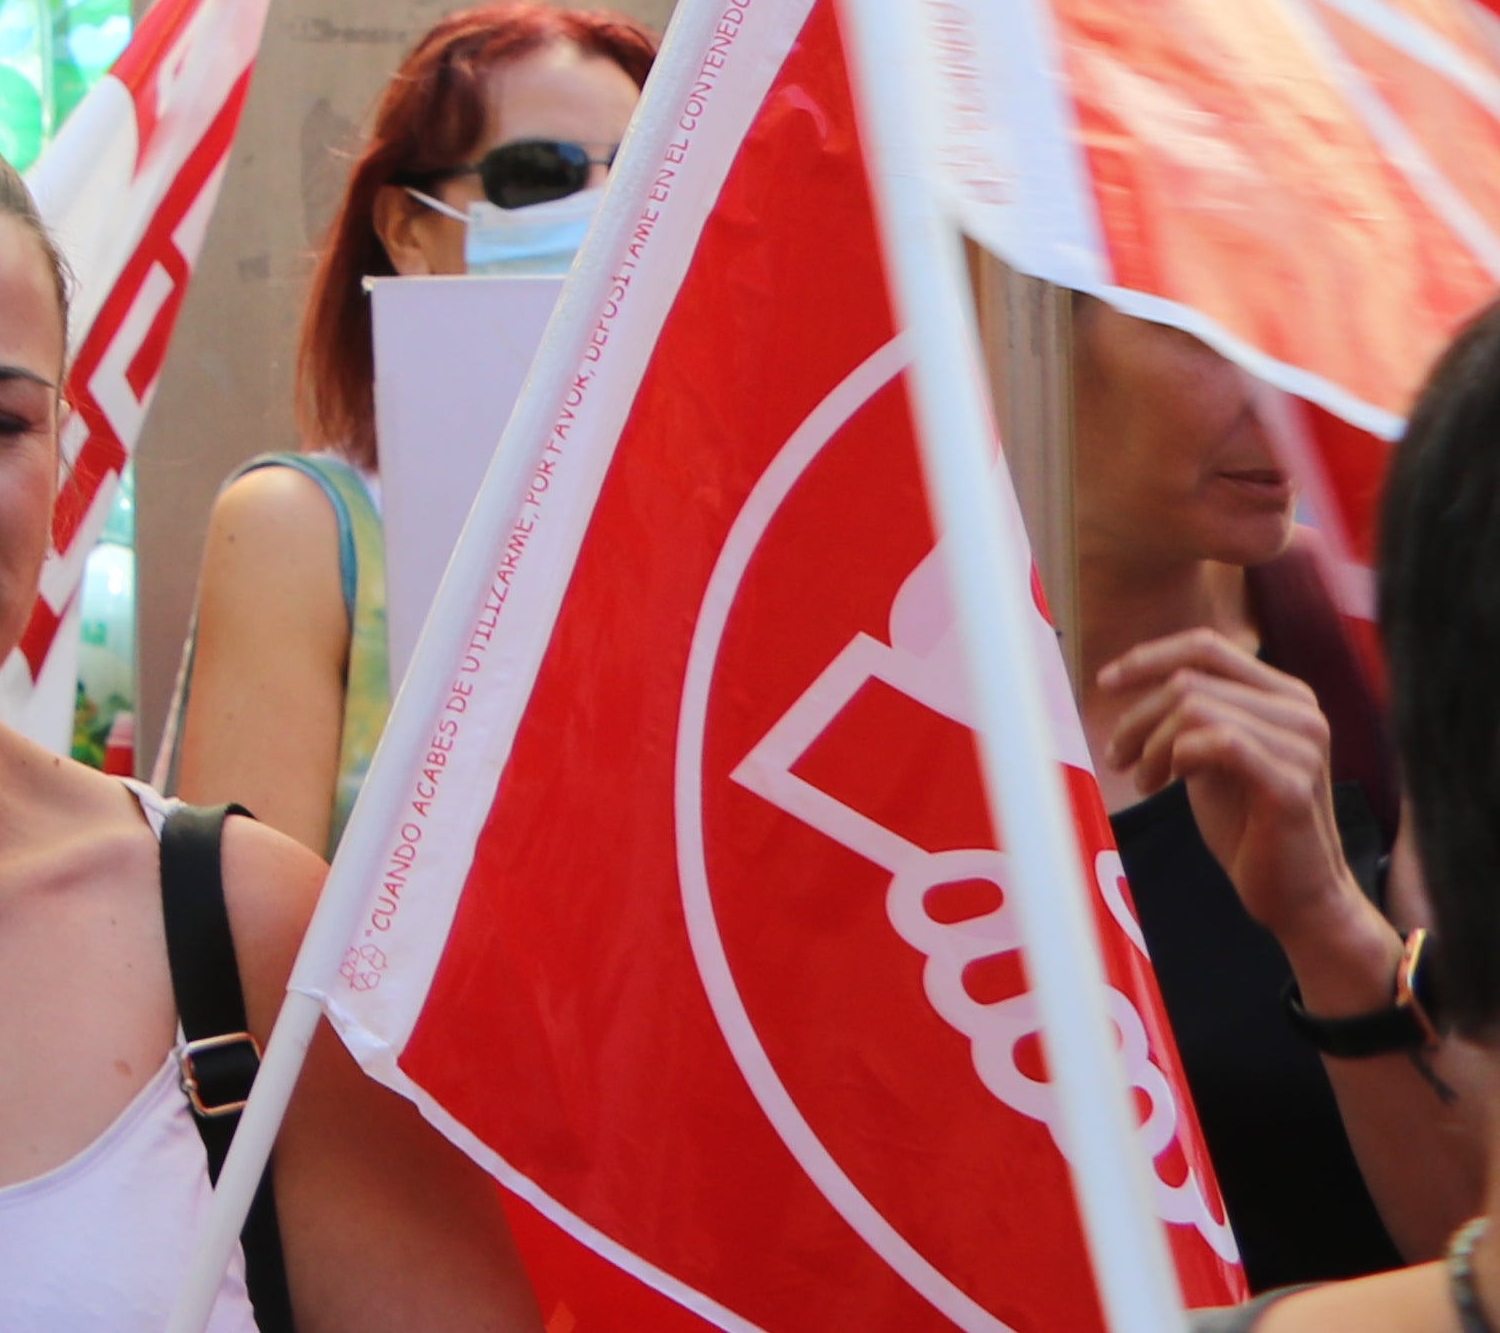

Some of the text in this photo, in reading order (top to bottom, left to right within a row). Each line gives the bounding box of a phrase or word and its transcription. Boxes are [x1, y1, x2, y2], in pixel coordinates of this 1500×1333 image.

[412, 718, 458, 817] ACABES
[446, 680, 475, 715] DE
[649, 167, 676, 205] EN
[665, 137, 691, 169] EL
